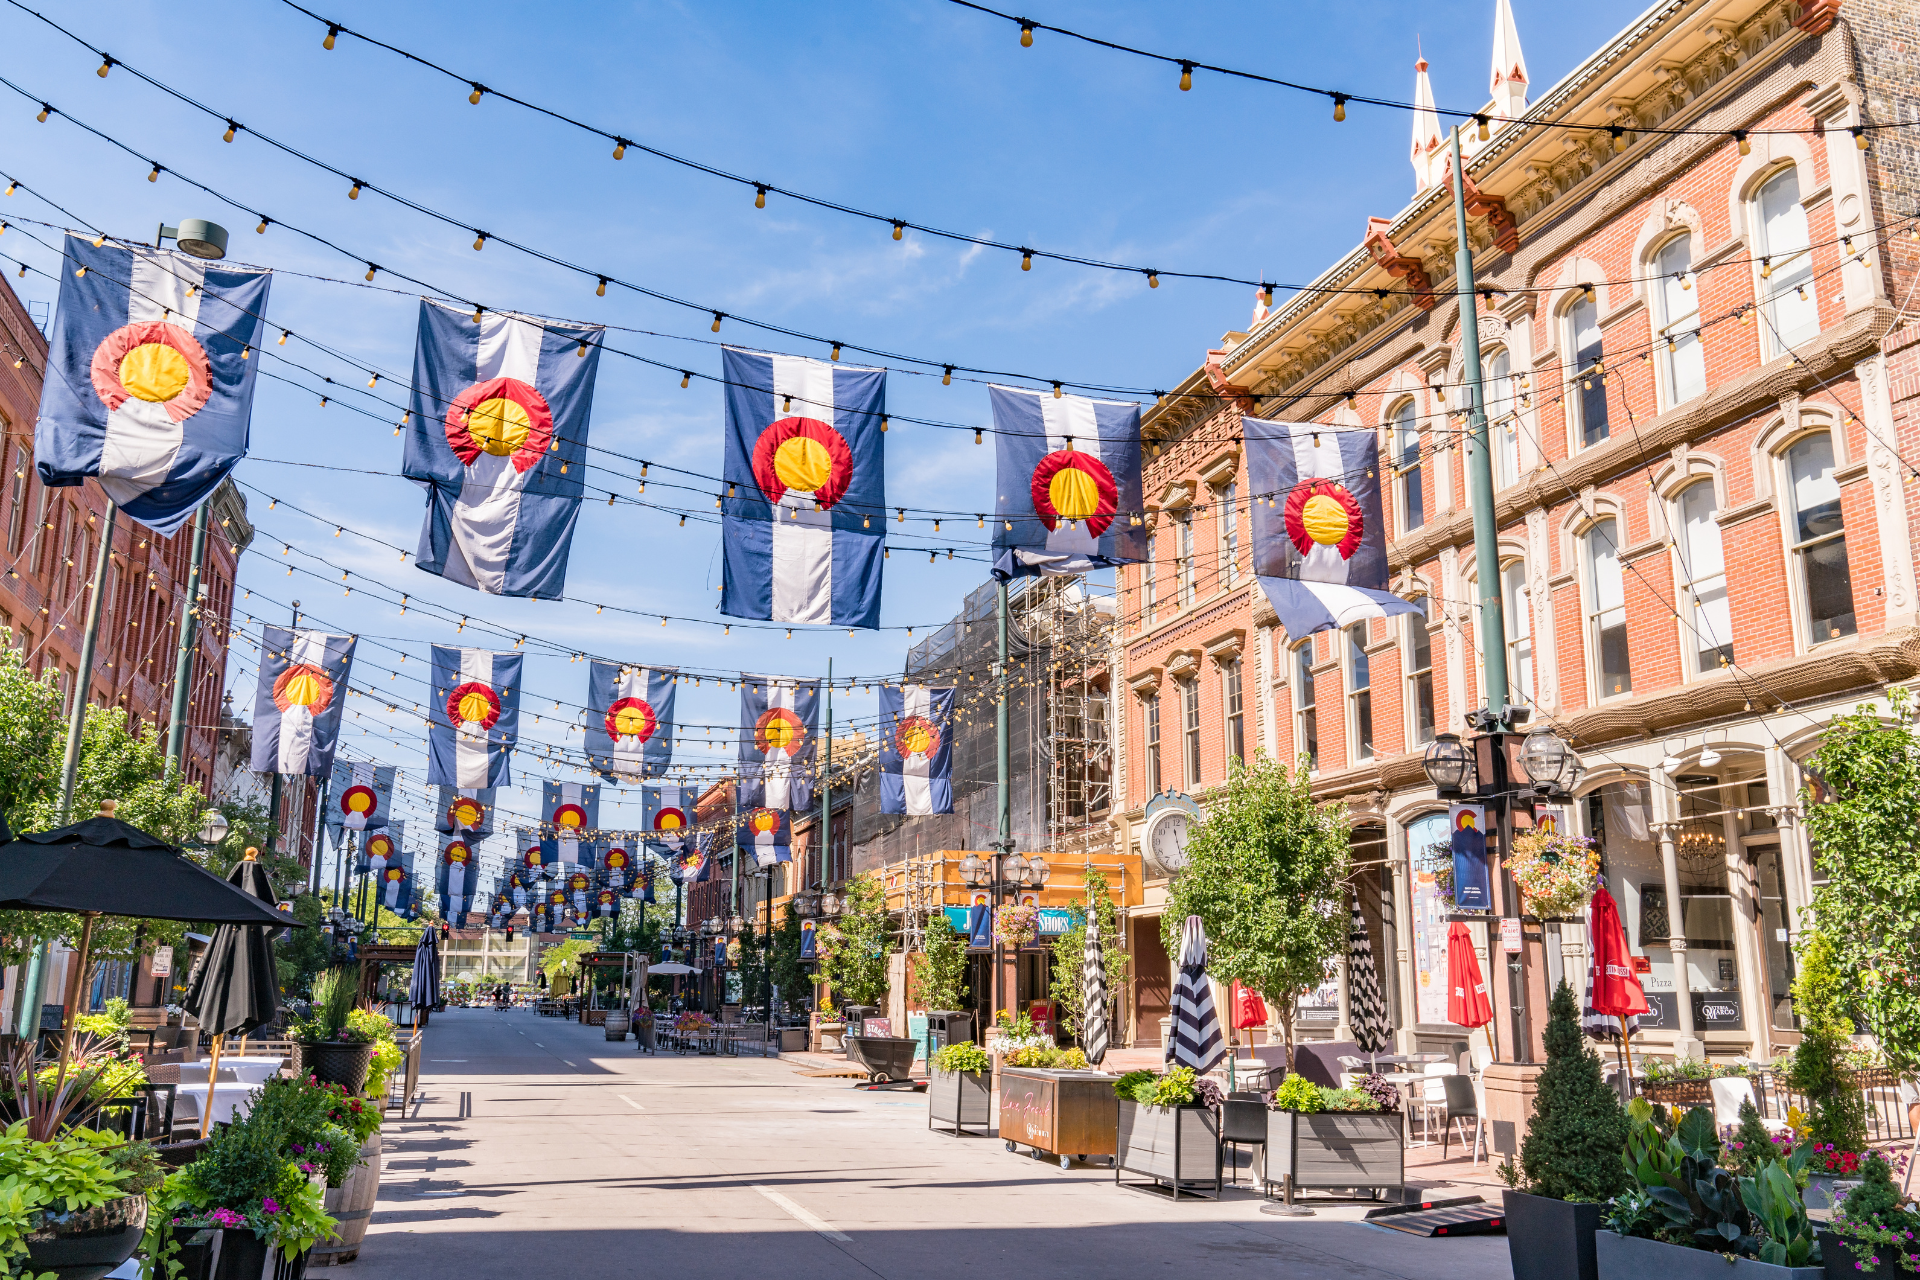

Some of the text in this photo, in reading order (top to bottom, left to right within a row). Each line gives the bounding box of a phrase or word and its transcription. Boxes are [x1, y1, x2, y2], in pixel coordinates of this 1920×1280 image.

[1151, 799, 1194, 811] THE MARKET
[1164, 855, 1170, 864] 7
[1414, 859, 1425, 871] OF
[1039, 913, 1069, 932] SHOES
[1650, 976, 1672, 987] Pizza
[1706, 1009, 1735, 1019] MARCO
